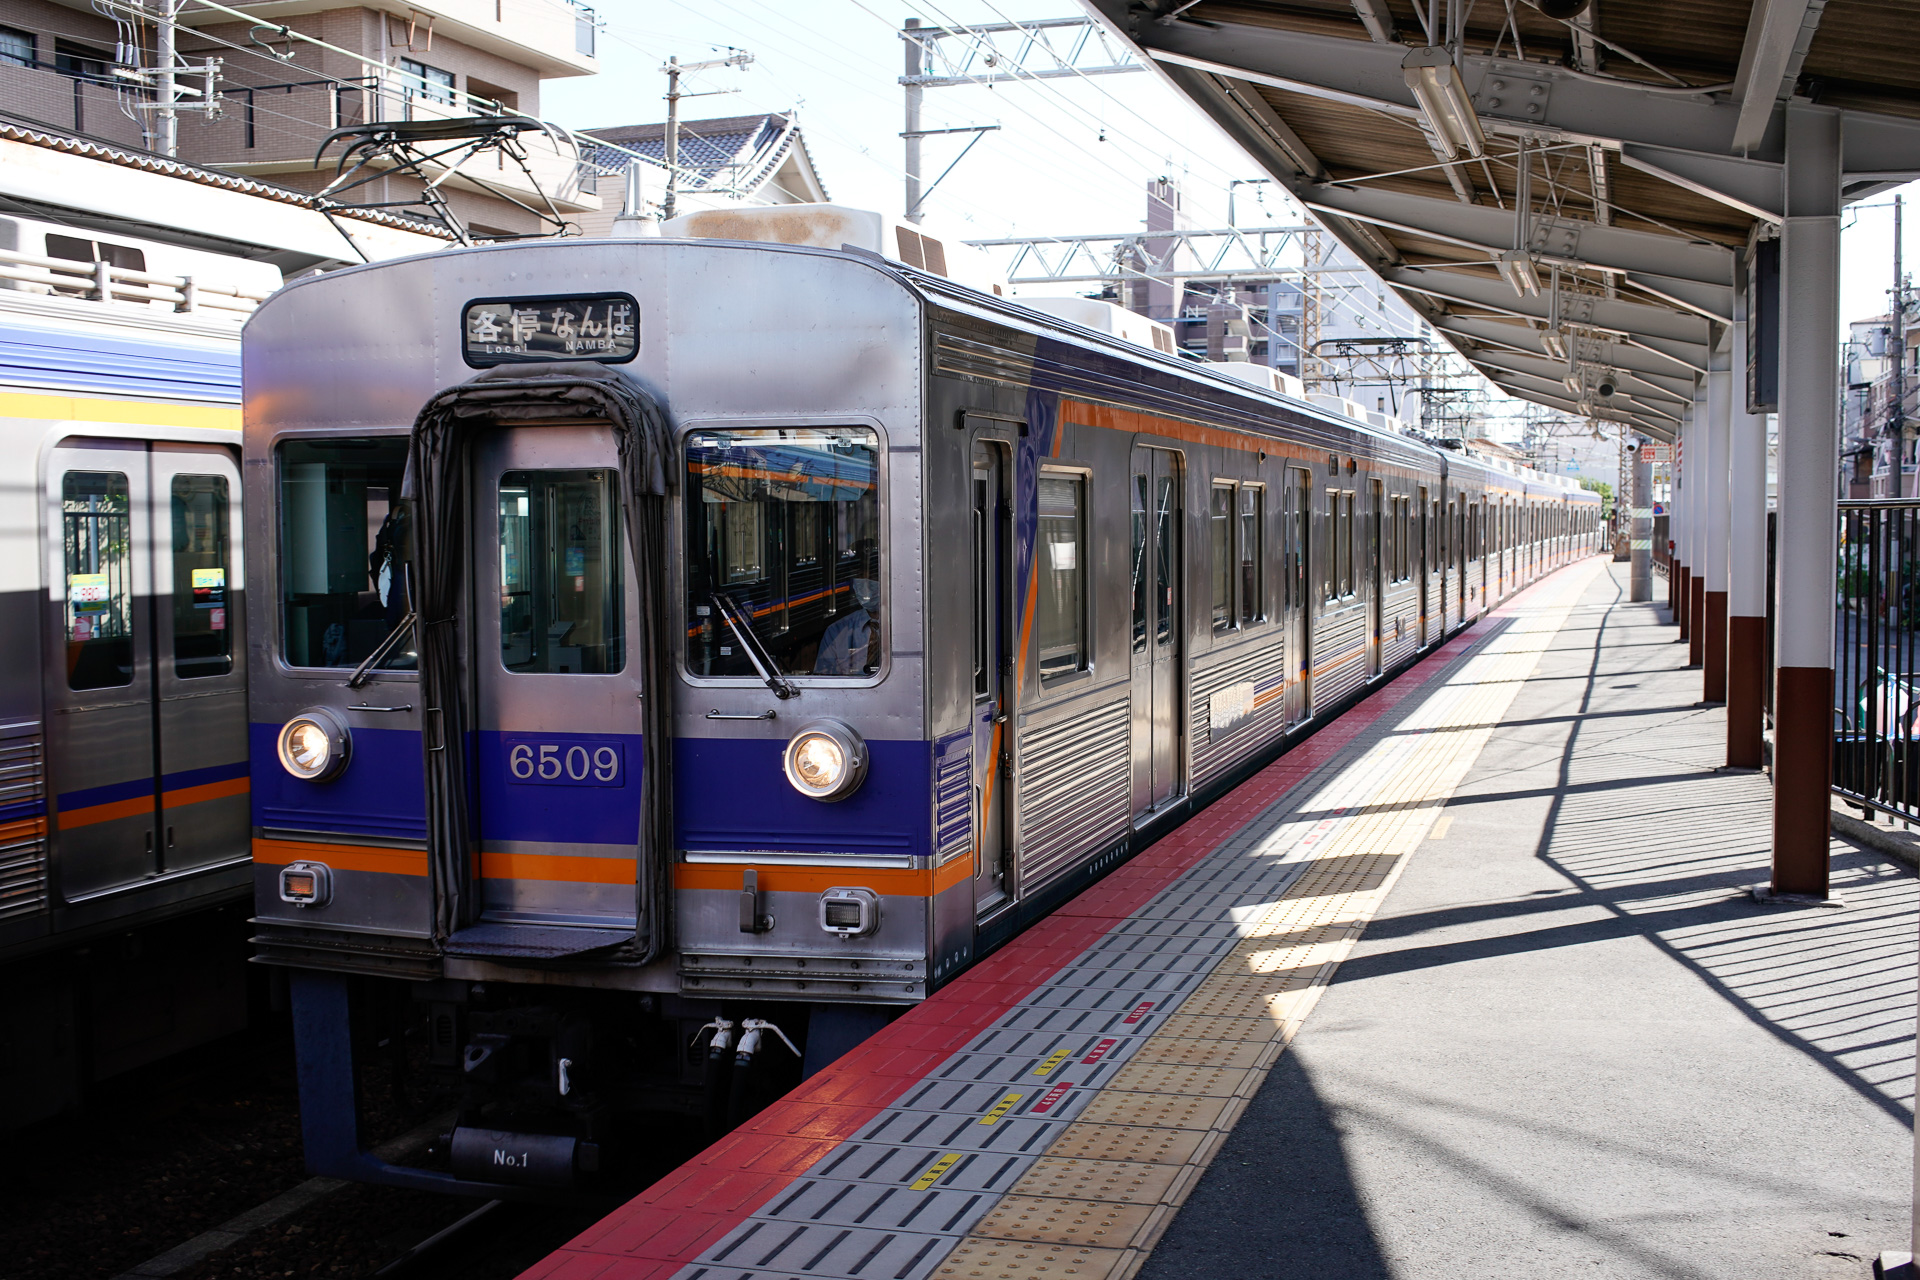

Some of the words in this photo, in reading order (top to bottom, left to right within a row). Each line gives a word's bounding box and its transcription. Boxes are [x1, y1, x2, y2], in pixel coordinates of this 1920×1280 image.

[472, 308, 541, 343] 各停
[551, 303, 631, 338] なんば
[486, 343, 528, 354] Local
[565, 339, 617, 351] NAMBA
[510, 744, 619, 782] 6509
[493, 1149, 528, 1168] No.1
